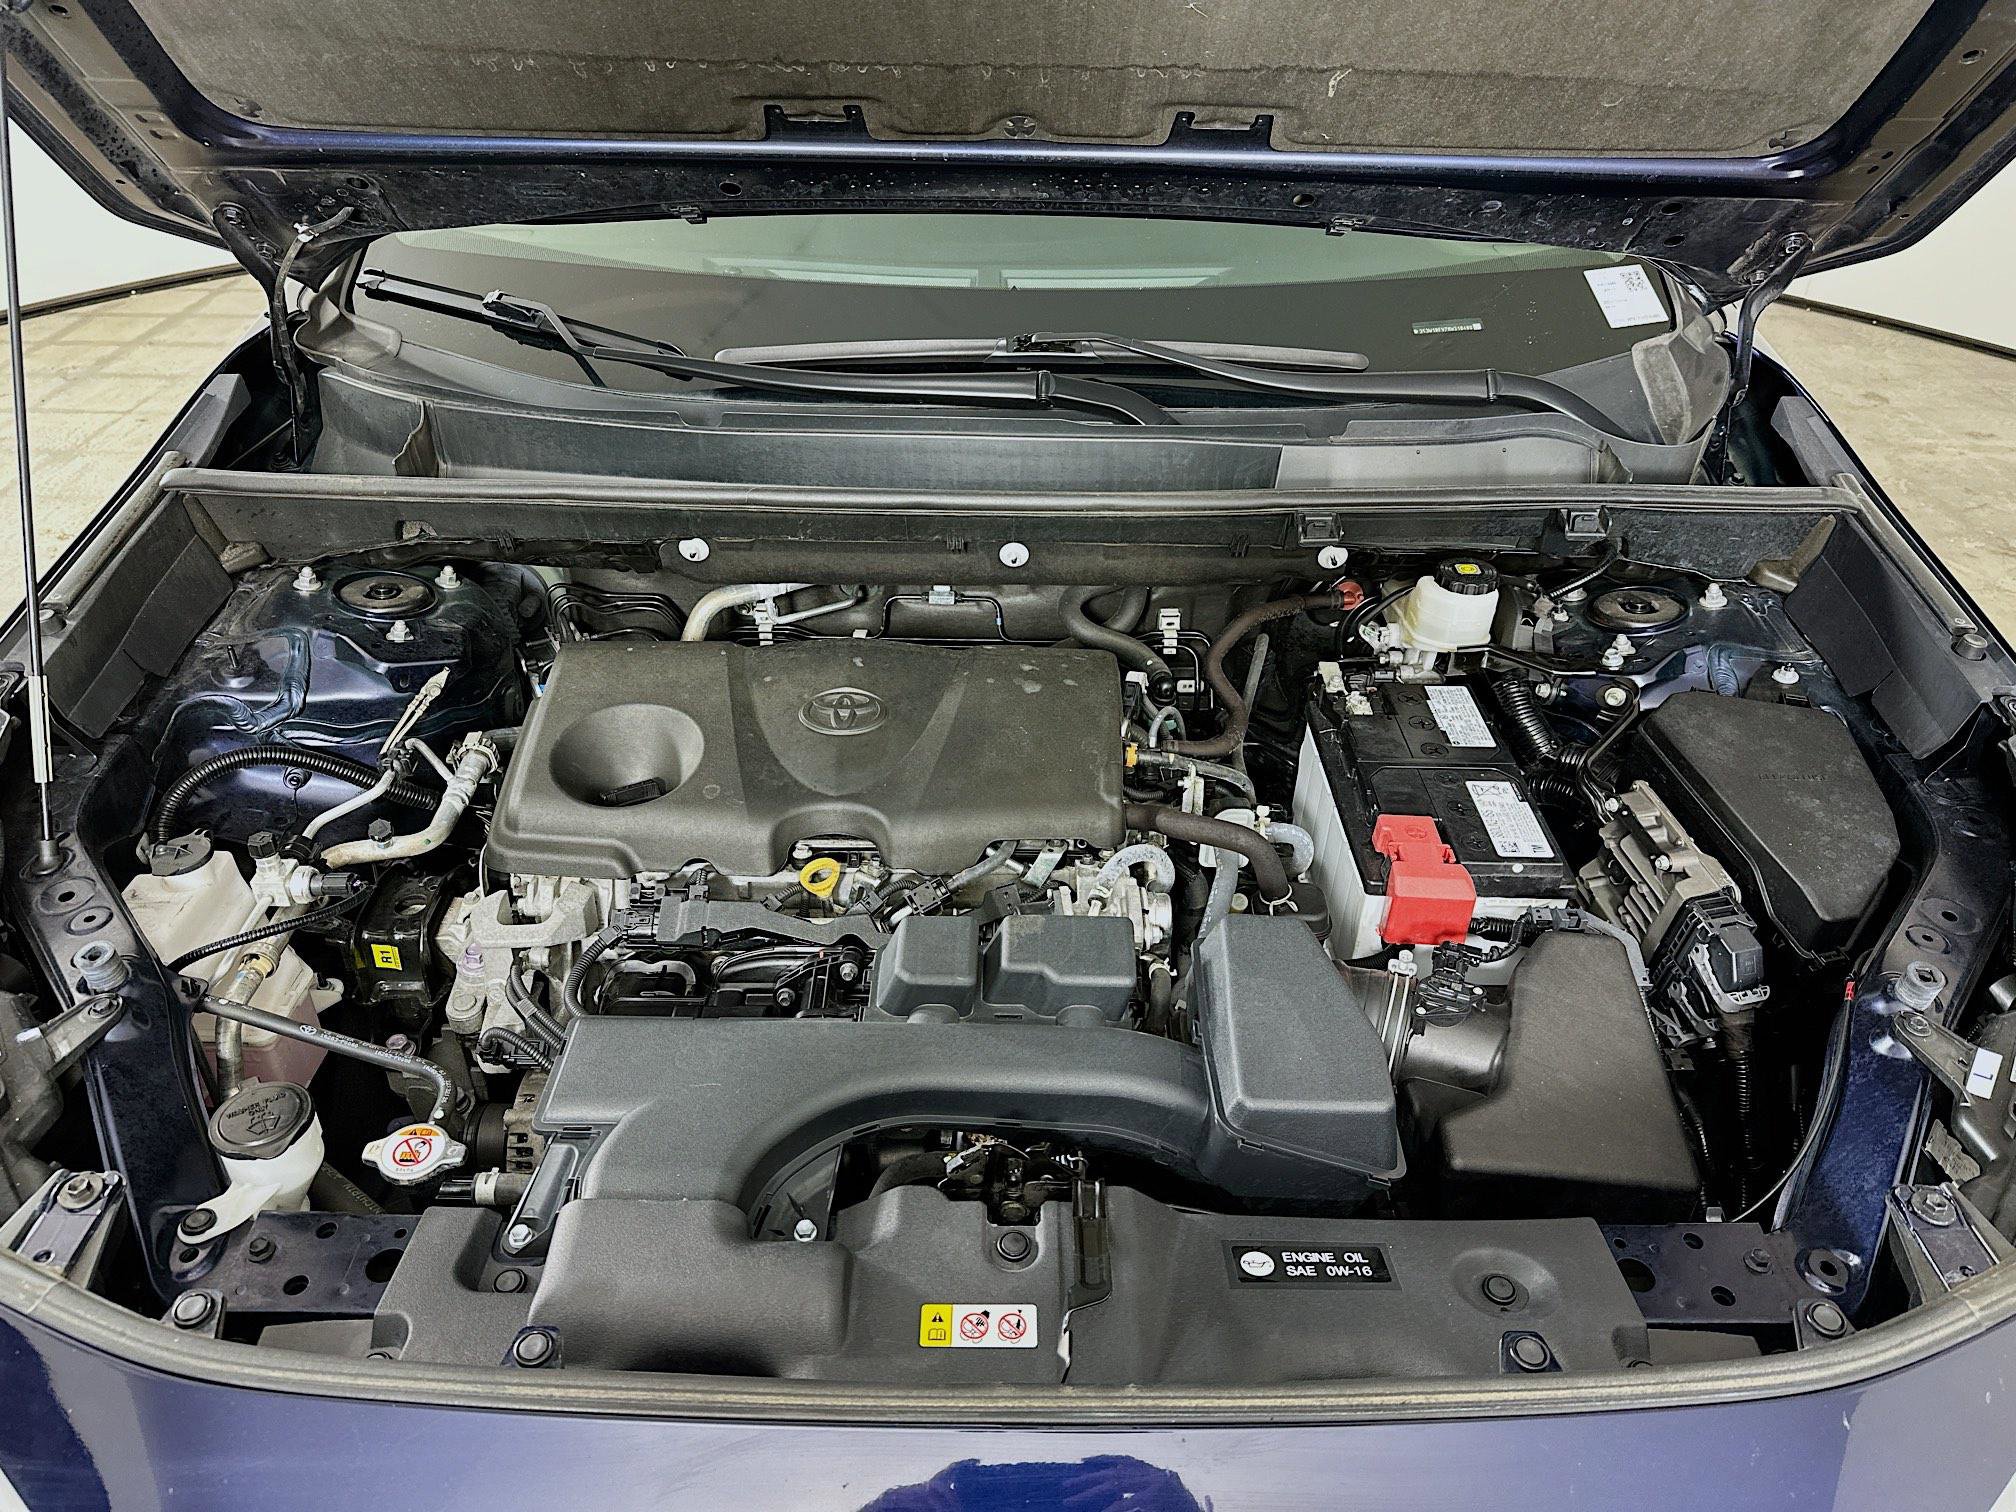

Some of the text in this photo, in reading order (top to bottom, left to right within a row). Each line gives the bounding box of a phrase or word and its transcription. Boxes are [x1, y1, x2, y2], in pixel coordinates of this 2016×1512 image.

[380, 950, 393, 964] R1
[226, 1102, 261, 1120] WASHER
[248, 1105, 269, 1117] ONLY
[1281, 1251, 1369, 1263] ENGINE OIL
[1285, 1265, 1373, 1277] SAE 0W-16
